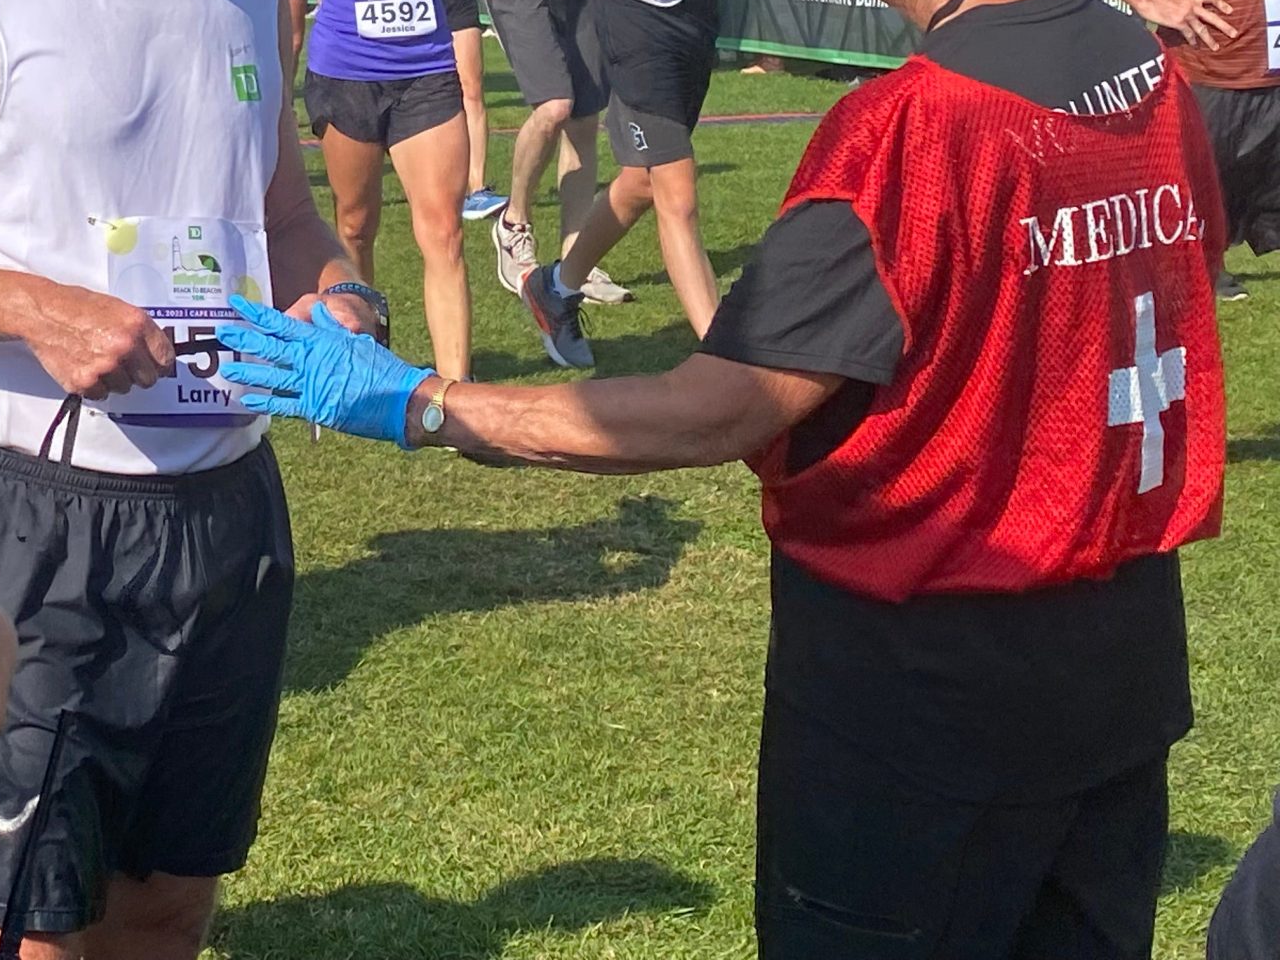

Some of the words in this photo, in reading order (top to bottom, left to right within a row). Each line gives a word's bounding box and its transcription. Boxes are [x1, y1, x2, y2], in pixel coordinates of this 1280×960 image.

[361, 1, 432, 24] 4592
[381, 25, 416, 34] Jessica
[235, 72, 258, 94] TD
[189, 310, 208, 318] CAPE
[177, 385, 232, 407] Larry
